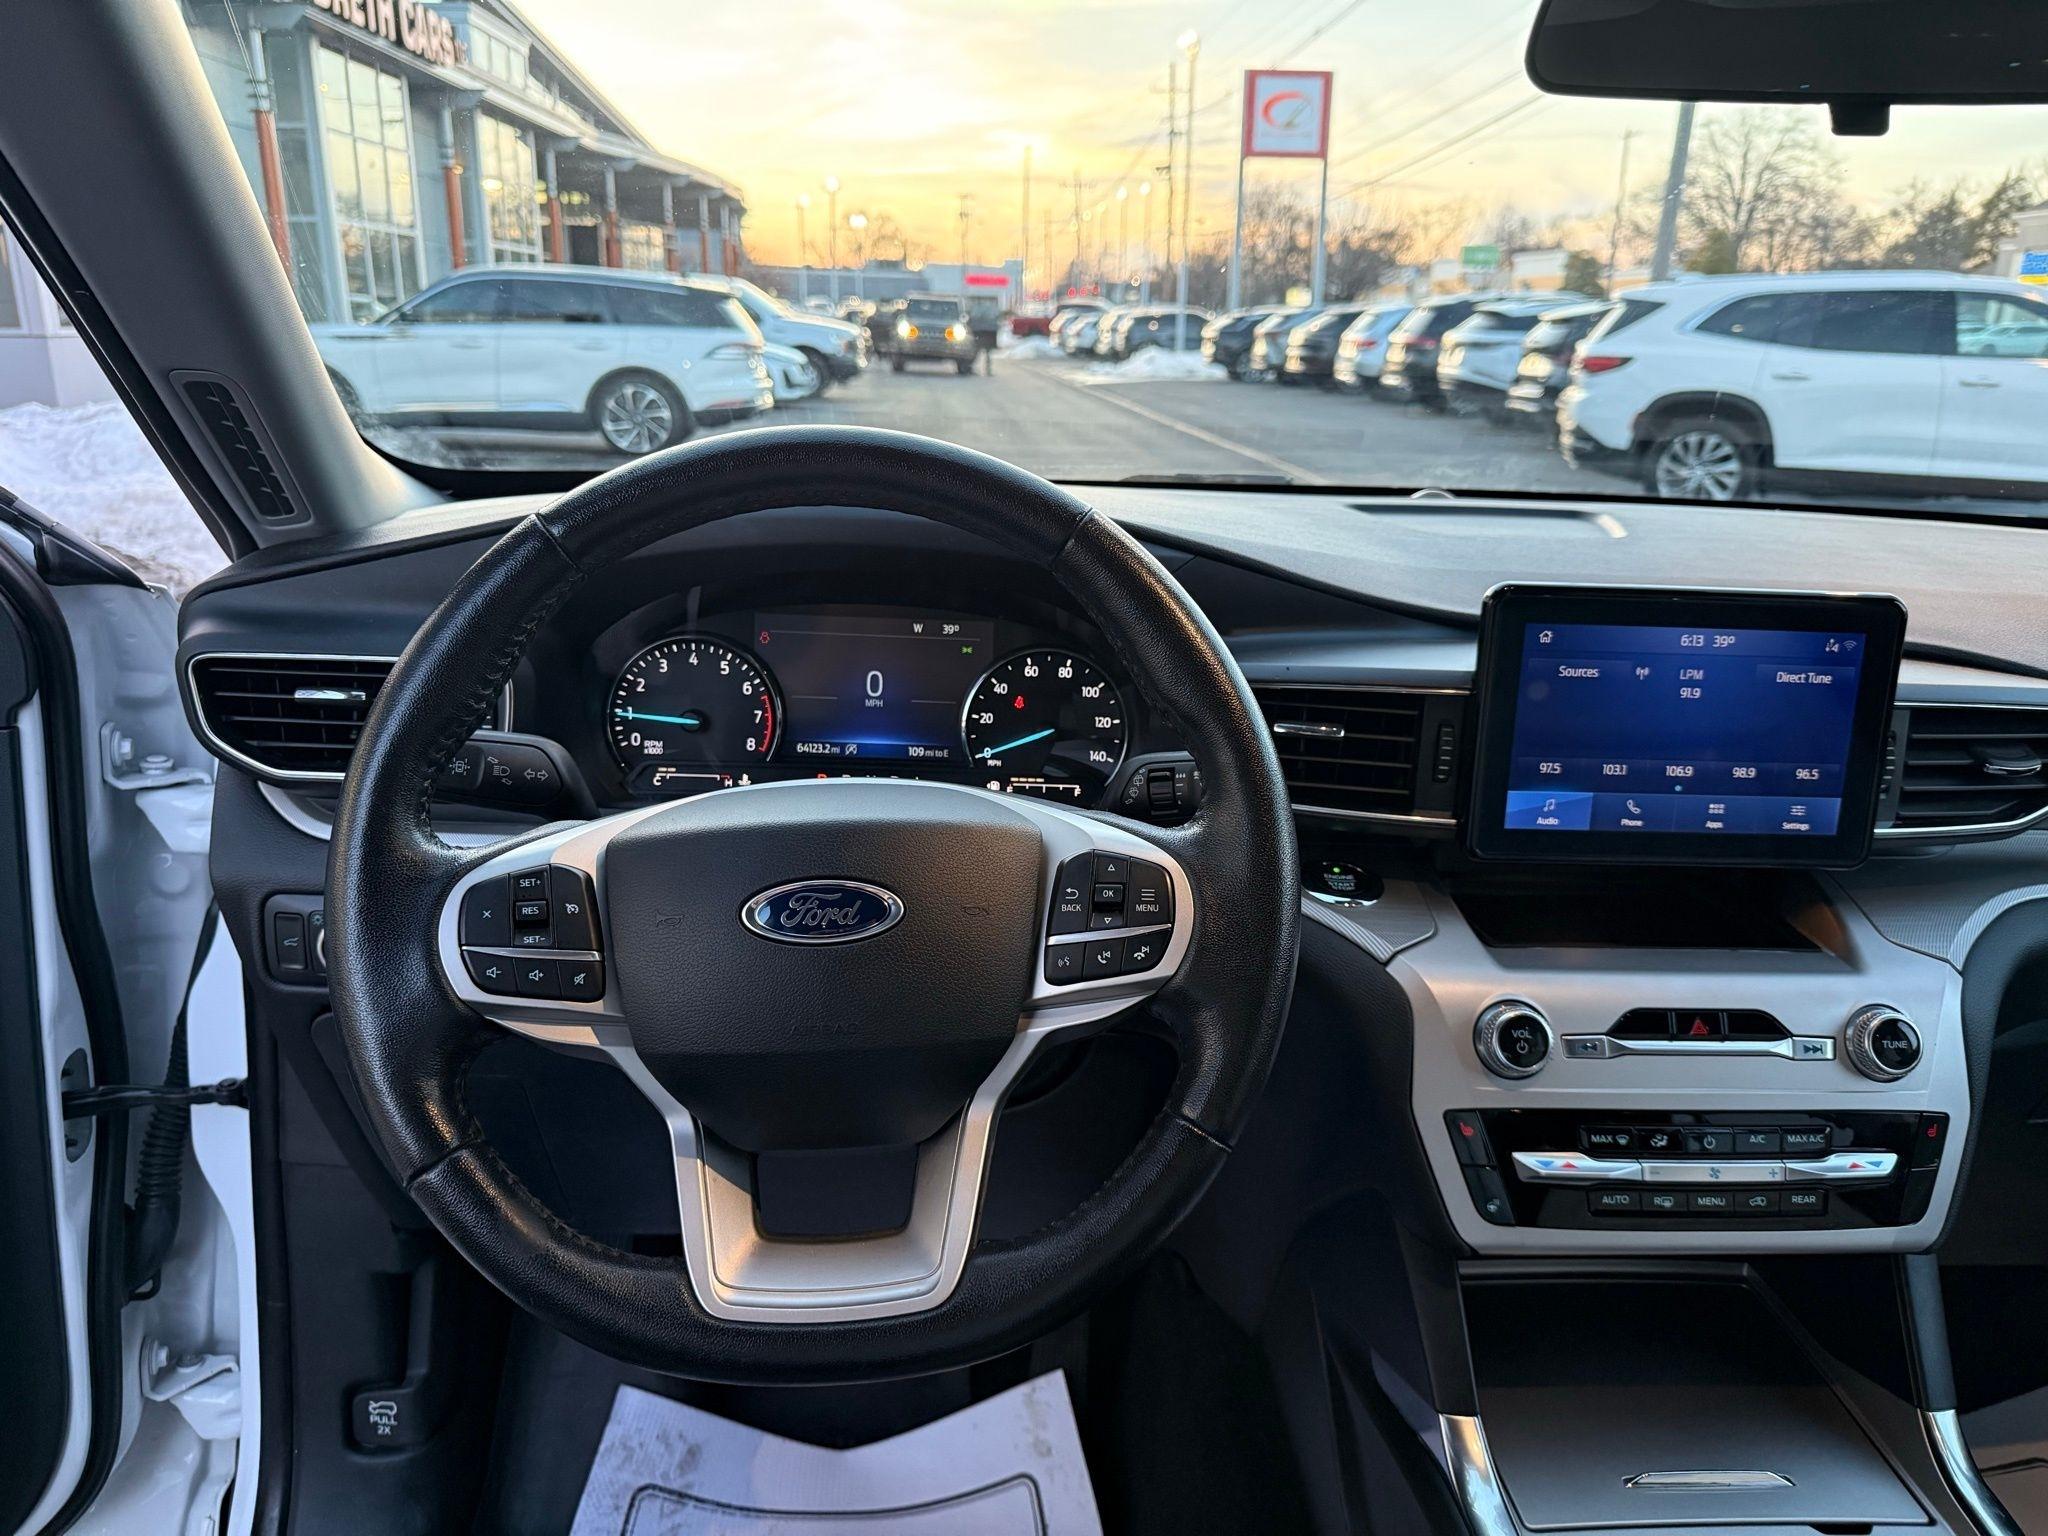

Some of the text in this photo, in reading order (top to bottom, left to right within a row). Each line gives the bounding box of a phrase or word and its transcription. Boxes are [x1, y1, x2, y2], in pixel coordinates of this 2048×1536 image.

[913, 623, 923, 633] W
[1680, 634, 1704, 647] 6:13
[689, 653, 698, 665] 4
[659, 659, 668, 672] 3
[720, 661, 729, 675] 5
[1024, 665, 1039, 678] 60
[1058, 667, 1073, 679] 80
[1558, 665, 1600, 678] Sources
[1679, 668, 1704, 680] LPM
[1776, 671, 1833, 684] Direct Tune
[636, 678, 645, 692] 2
[743, 681, 752, 695] 6
[866, 670, 884, 697] 0
[993, 683, 1008, 695] 40
[1081, 686, 1100, 698] 100
[1679, 687, 1701, 699] 91.9
[865, 699, 884, 707] MPH
[627, 707, 633, 720] 1
[754, 710, 762, 724] 7
[979, 712, 994, 724] 20
[1095, 716, 1111, 728] 120
[630, 733, 641, 746] 0
[644, 740, 663, 748] RPM
[746, 738, 756, 751] 8
[796, 743, 840, 754] 64123.2 mi
[908, 746, 924, 757] 109
[925, 749, 934, 757] mi
[943, 750, 949, 758] E
[983, 747, 991, 758] 0
[1089, 750, 1107, 762] 140
[987, 759, 1002, 767] MPH
[1539, 762, 1562, 774] 97.5
[1602, 764, 1628, 775] 103.1
[1666, 765, 1694, 777] 106.9
[1732, 767, 1757, 779] 98.9
[1795, 768, 1820, 780] 96.5
[653, 776, 662, 786] C
[724, 778, 733, 788] H
[1074, 788, 1082, 797] F
[1536, 817, 1559, 826] Audio
[1620, 818, 1645, 827] Phone
[1705, 820, 1724, 830] Apps
[1781, 822, 1810, 831] Settings
[519, 878, 541, 887] SET+
[1102, 890, 1114, 898] OK
[522, 906, 539, 915] RES
[780, 893, 862, 928] Ford
[1061, 904, 1082, 912] BACK
[1135, 904, 1159, 912] MENU
[1512, 1029, 1532, 1039] VOL
[1882, 1040, 1908, 1049] TUNE
[1591, 1134, 1613, 1143] MAX
[1749, 1135, 1766, 1143] A/C
[1787, 1135, 1825, 1143] MAX A/C
[1602, 1196, 1629, 1204] AUTO
[1698, 1197, 1726, 1206] MENU
[1791, 1195, 1816, 1204] REAR
[370, 1415, 398, 1425] PULL
[377, 1425, 391, 1435] 2X
